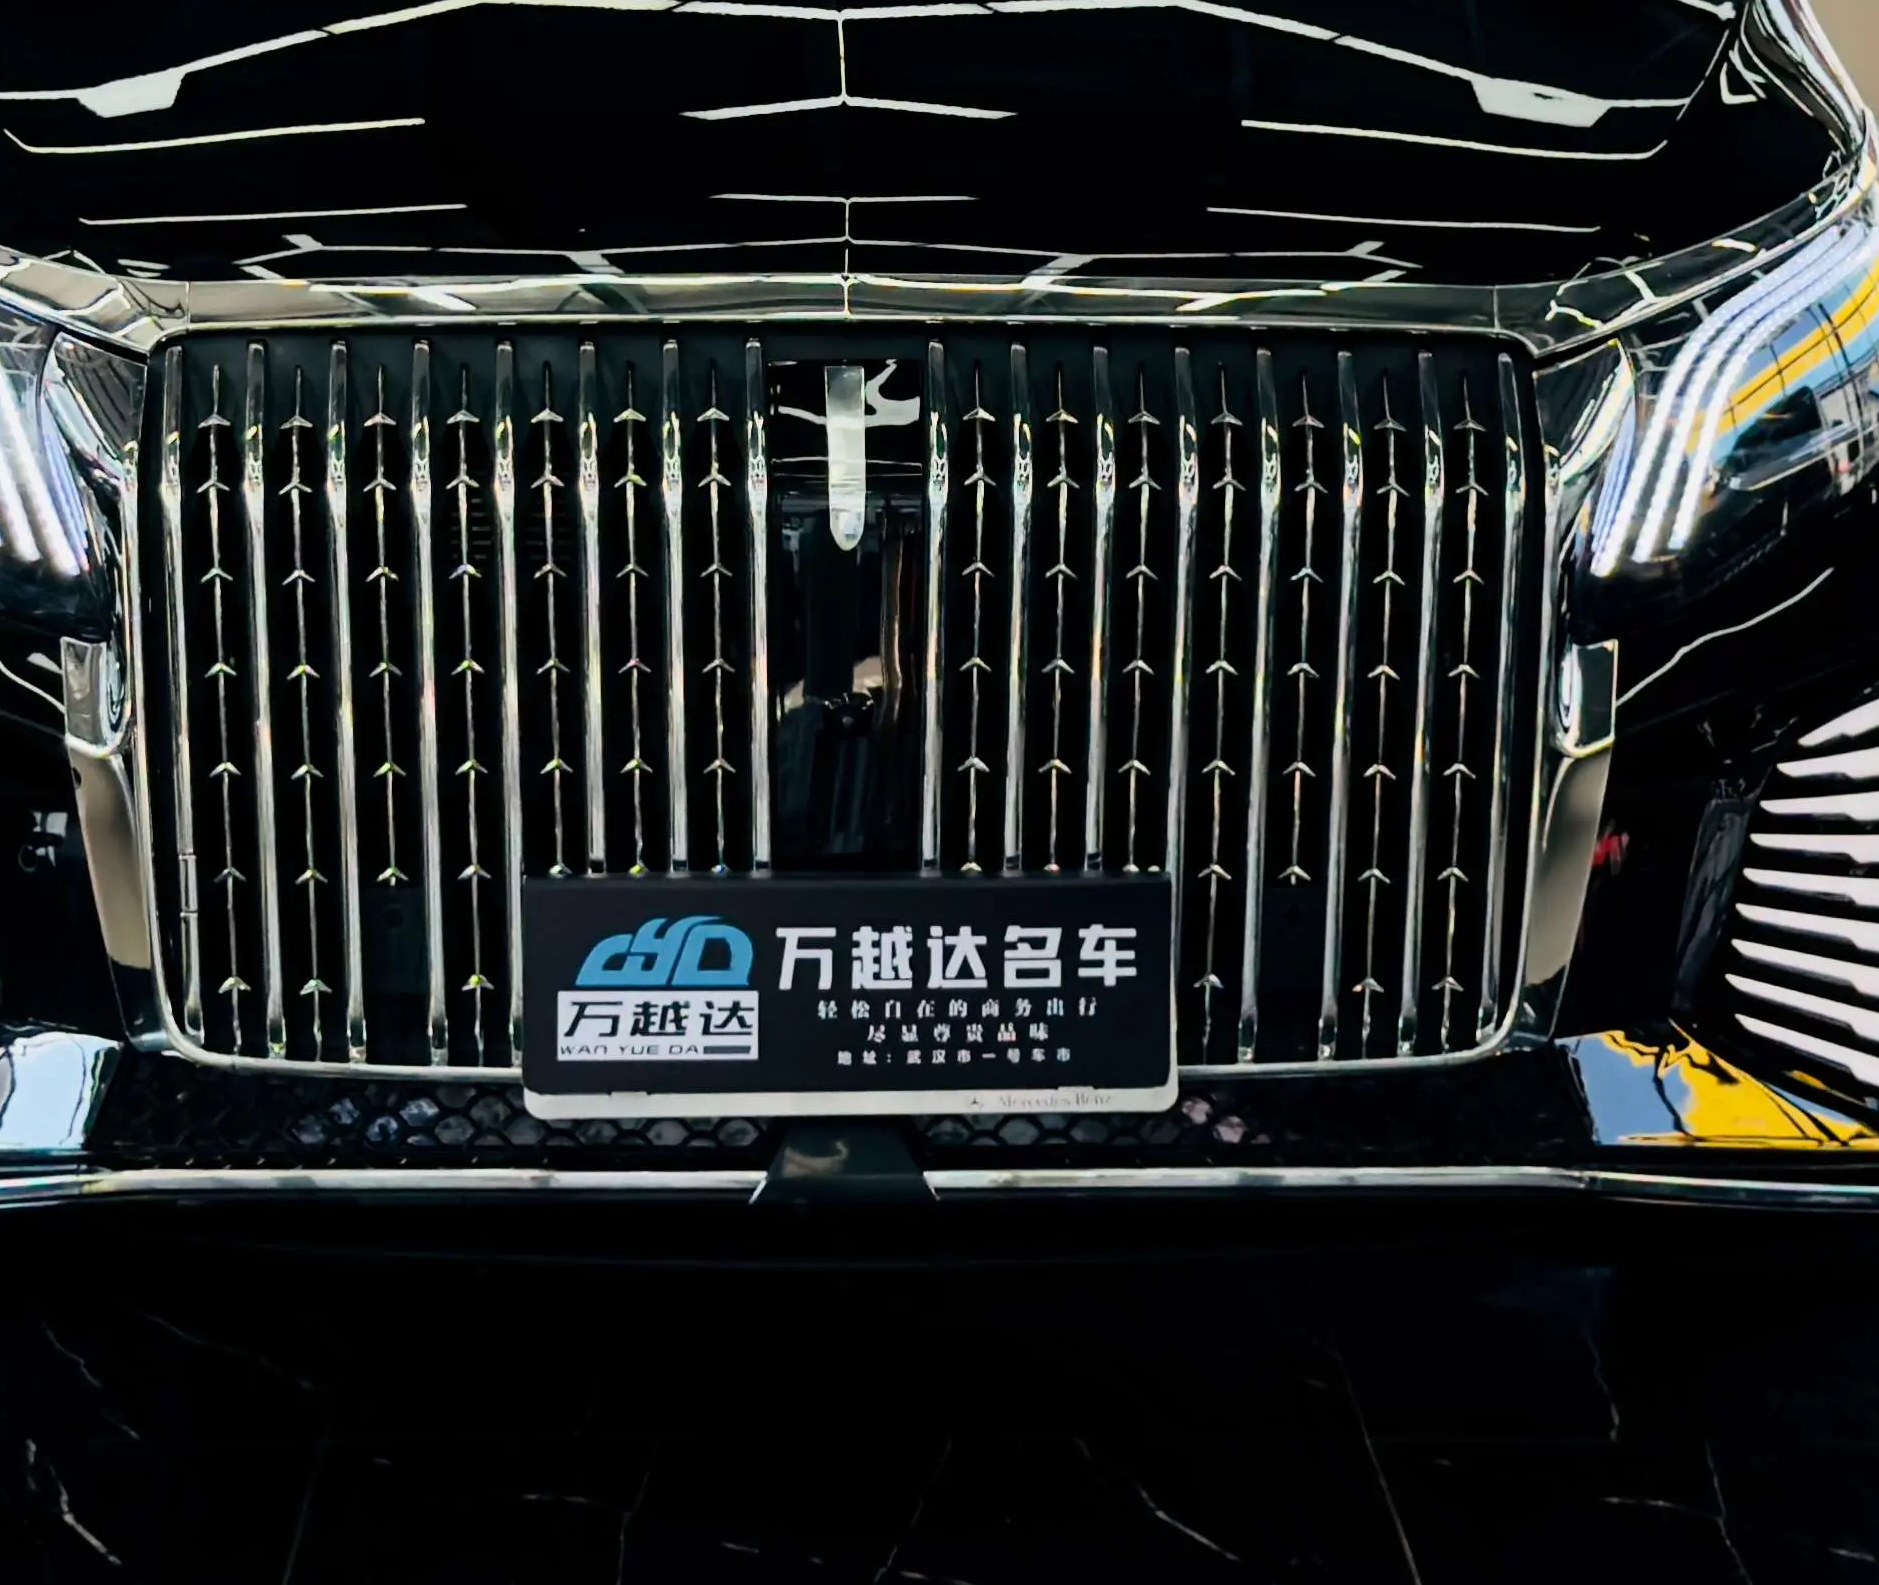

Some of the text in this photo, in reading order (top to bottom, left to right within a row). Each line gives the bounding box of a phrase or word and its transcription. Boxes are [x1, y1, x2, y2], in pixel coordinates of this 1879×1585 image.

[775, 924, 1138, 991] 万越达名车
[563, 1000, 755, 1038] 万越达
[618, 1044, 660, 1056] YUE
